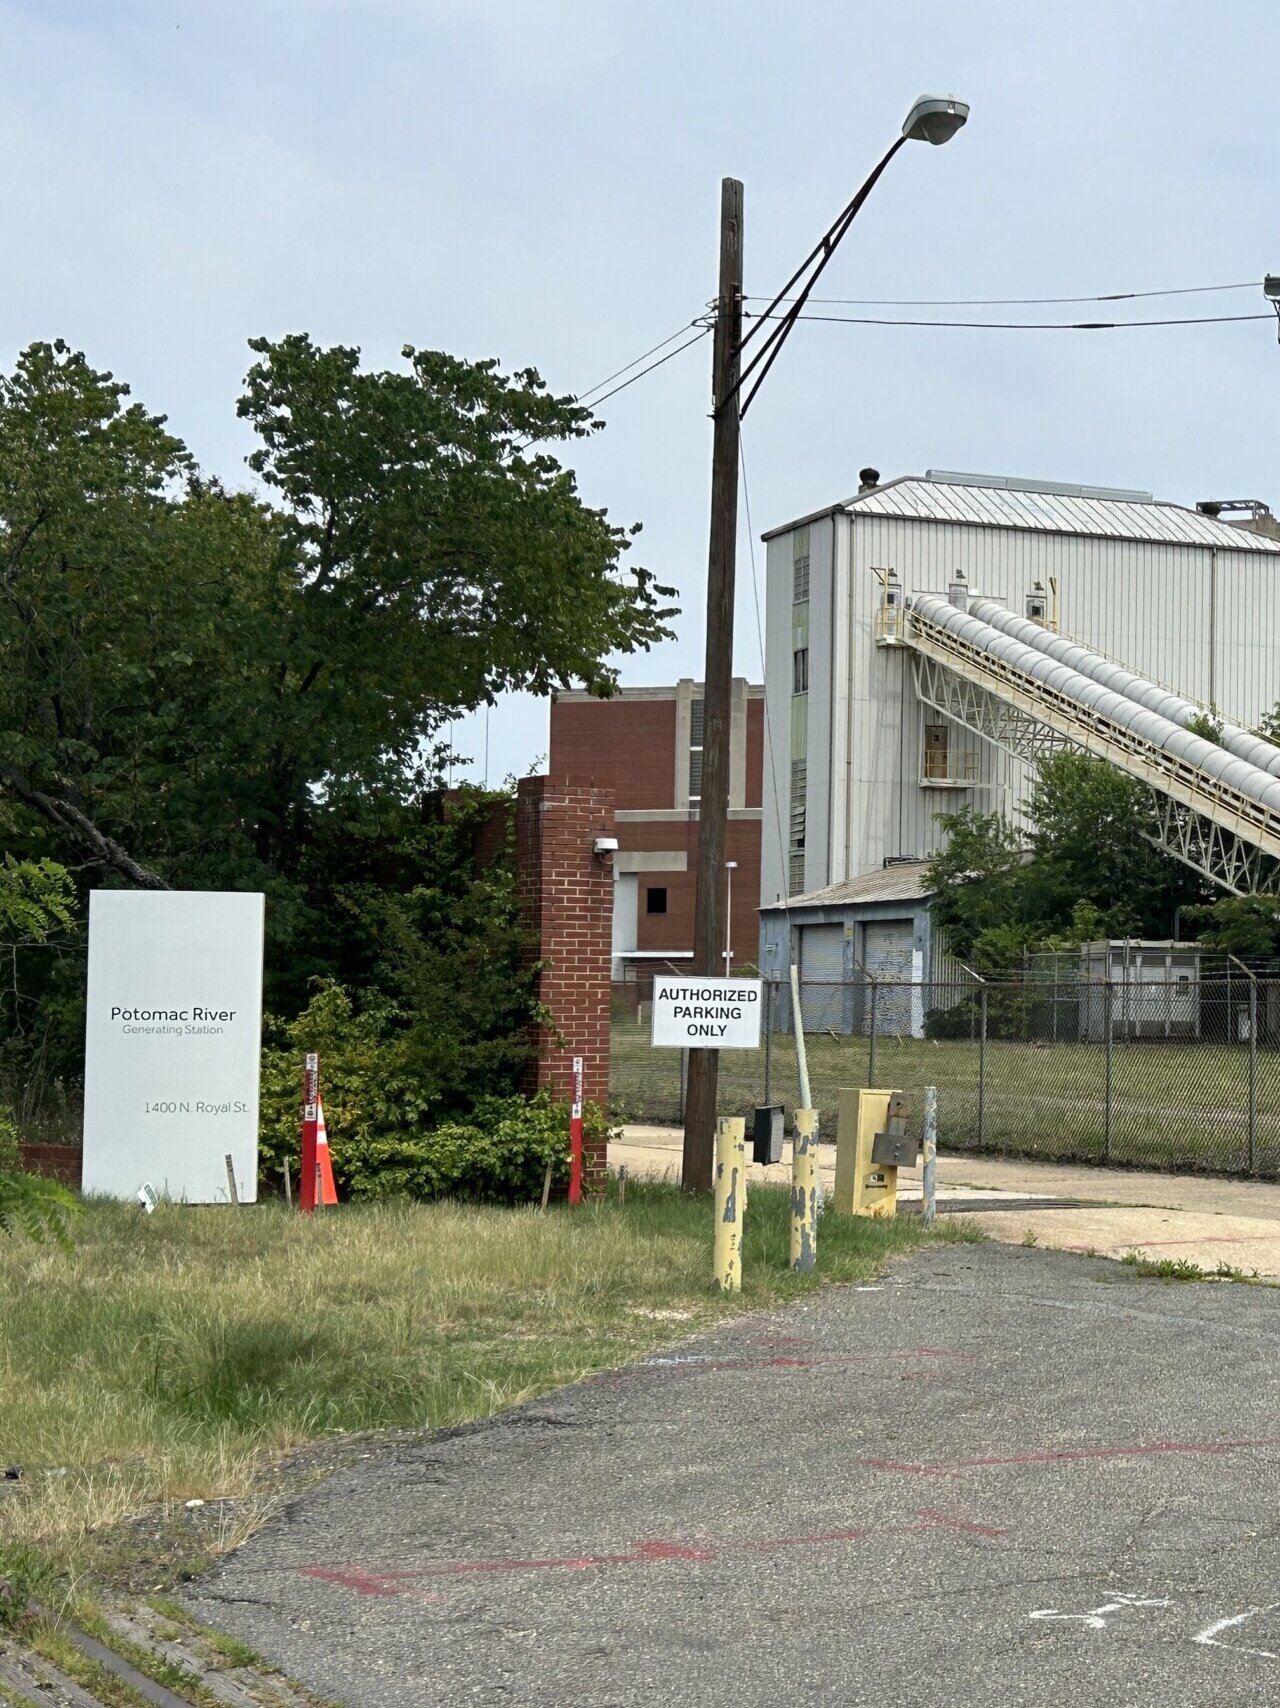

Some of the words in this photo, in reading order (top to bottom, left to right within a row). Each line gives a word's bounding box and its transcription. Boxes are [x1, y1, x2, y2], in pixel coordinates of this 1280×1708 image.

[658, 988, 758, 1002] AUTHORIZED
[111, 1007, 188, 1021] Potomac
[193, 1007, 236, 1021] River
[673, 1006, 742, 1019] PARKING
[122, 1024, 183, 1037] Generating
[184, 1024, 224, 1035] Station
[687, 1024, 728, 1037] ONLY
[144, 1102, 177, 1114] 1400
[179, 1102, 193, 1114] N.
[196, 1101, 231, 1116] Royal
[234, 1101, 250, 1114] St.
